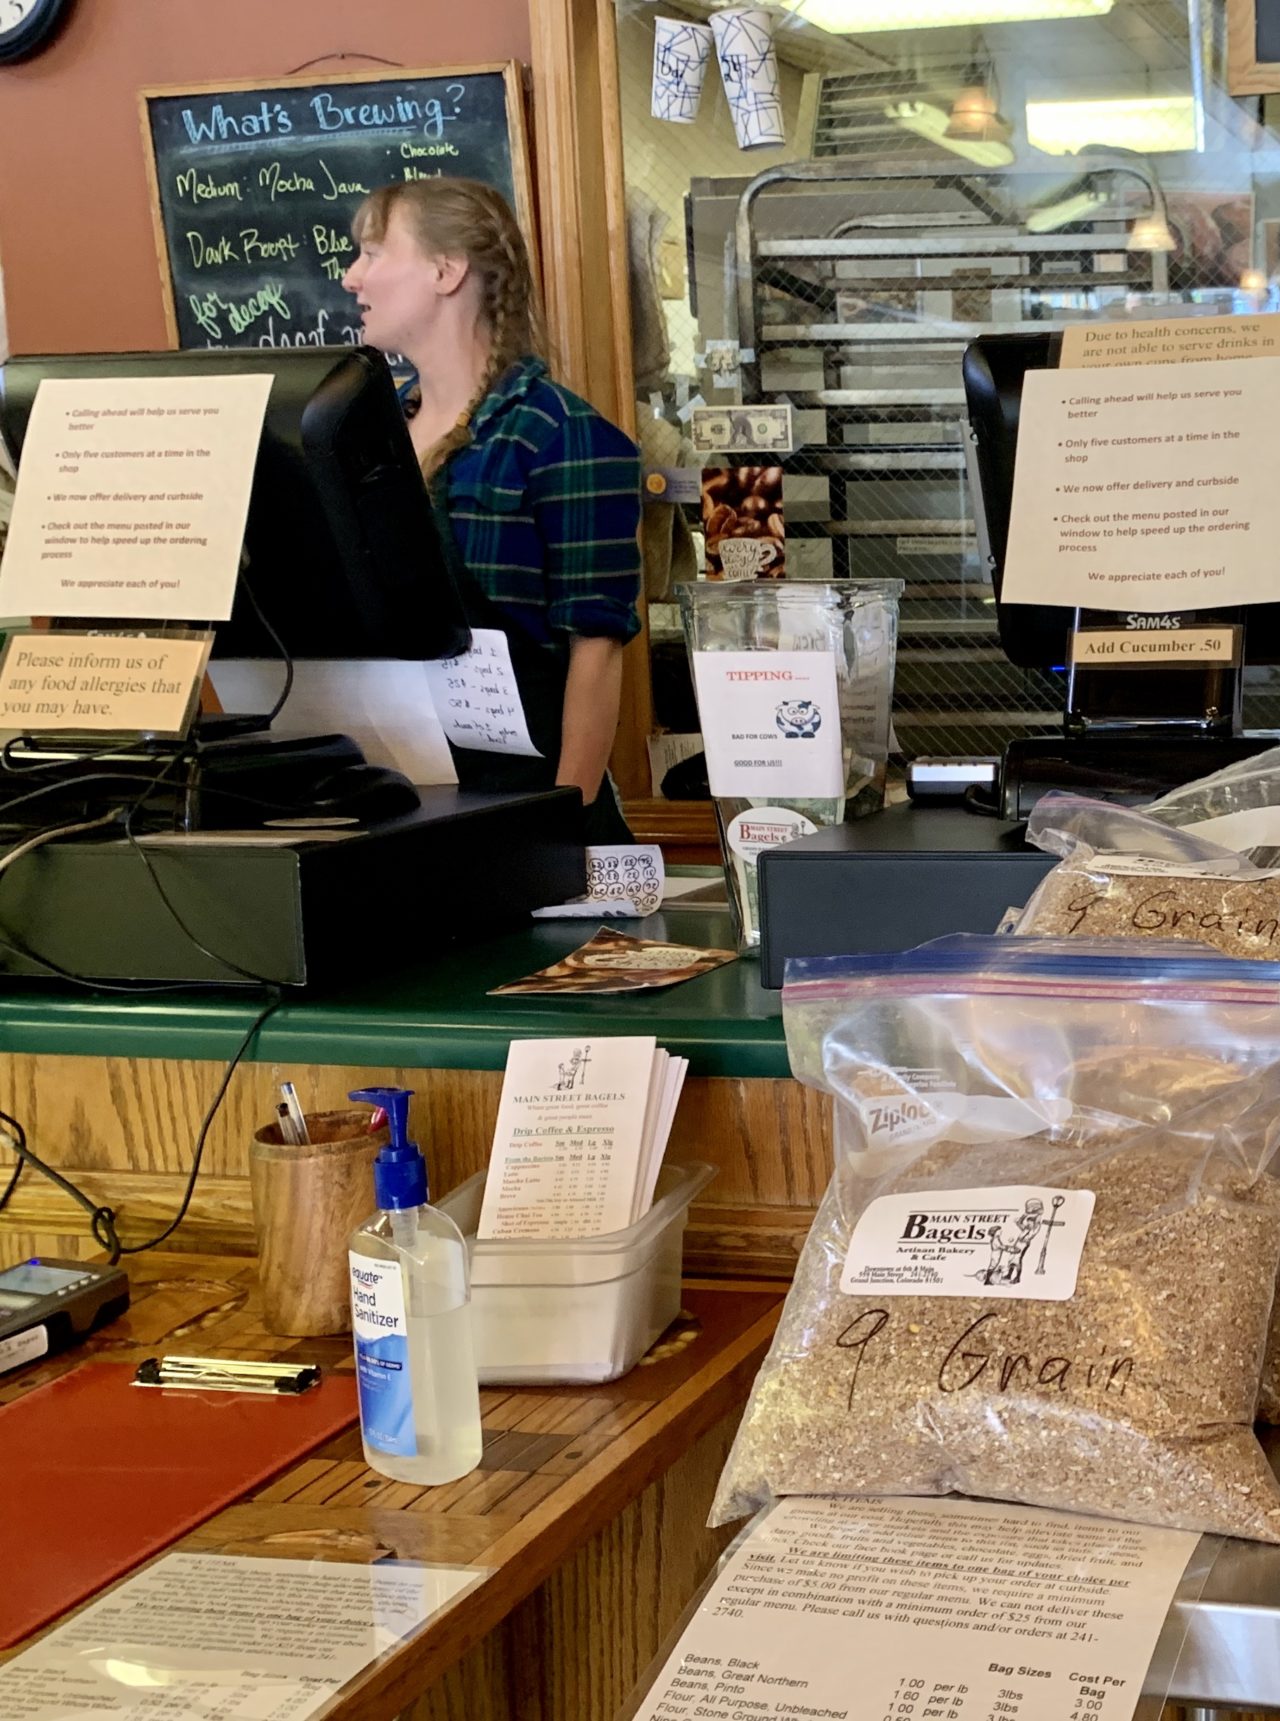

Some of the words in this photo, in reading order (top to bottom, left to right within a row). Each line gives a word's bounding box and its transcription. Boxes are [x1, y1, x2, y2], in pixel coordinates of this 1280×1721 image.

[182, 101, 292, 144] What's
[310, 84, 466, 138] Brewing?
[260, 162, 314, 200] Mocha
[319, 160, 370, 200] Java
[186, 232, 239, 268] Dark
[313, 225, 352, 255] Blue
[1085, 331, 1111, 342] Due
[1116, 329, 1128, 340] to
[1132, 327, 1171, 339] health
[1241, 324, 1260, 333] we
[1082, 348, 1102, 357] are
[1107, 346, 1127, 356] not
[1131, 343, 1157, 354] able
[1162, 342, 1174, 352] to
[1179, 342, 1212, 351] serve
[1217, 337, 1257, 348] drinks
[1262, 336, 1275, 347] in
[1065, 439, 1088, 448] Only
[1091, 438, 1109, 446] five
[1111, 436, 1162, 446] customers
[1165, 434, 1175, 442] at
[1186, 433, 1208, 441] time
[1223, 430, 1240, 439] the
[1065, 454, 1088, 463] shop
[1063, 485, 1080, 493] We
[1083, 484, 1103, 492] now
[1106, 482, 1130, 491] offer
[1133, 480, 1173, 490] delivery
[1176, 478, 1194, 487] and
[1197, 476, 1239, 487] curbside
[1088, 572, 1105, 581] We
[1108, 570, 1162, 583] appreciate
[1165, 570, 1187, 579] each
[1191, 569, 1201, 578] of
[1203, 566, 1226, 577] you!
[1084, 642, 1115, 655] Add
[1120, 640, 1196, 654] Cucumber
[1200, 640, 1221, 652] .50
[16, 652, 64, 667] Please
[68, 652, 120, 669] inform
[125, 658, 142, 670] us
[147, 654, 168, 670] of
[8, 678, 37, 694] any
[41, 675, 77, 691] food
[80, 677, 146, 696] allergies
[151, 678, 182, 694] that
[0, 701, 30, 717] you
[35, 701, 69, 718] may
[73, 700, 112, 715] have.
[740, 824, 779, 842] Bagels
[1132, 890, 1280, 944] Grain
[929, 1215, 960, 1223] MAIN
[963, 1214, 1009, 1223] STREET
[900, 1214, 985, 1244] Bagels
[352, 1290, 376, 1307] Hand
[354, 1304, 399, 1329] Sanitizer
[836, 1308, 890, 1412] 9
[937, 1313, 1135, 1396] Grain
[727, 1658, 760, 1670] Black
[988, 1663, 1014, 1676] Bag
[1017, 1666, 1052, 1679] Sizes
[1069, 1672, 1099, 1685] Cost
[1103, 1676, 1127, 1688] Per
